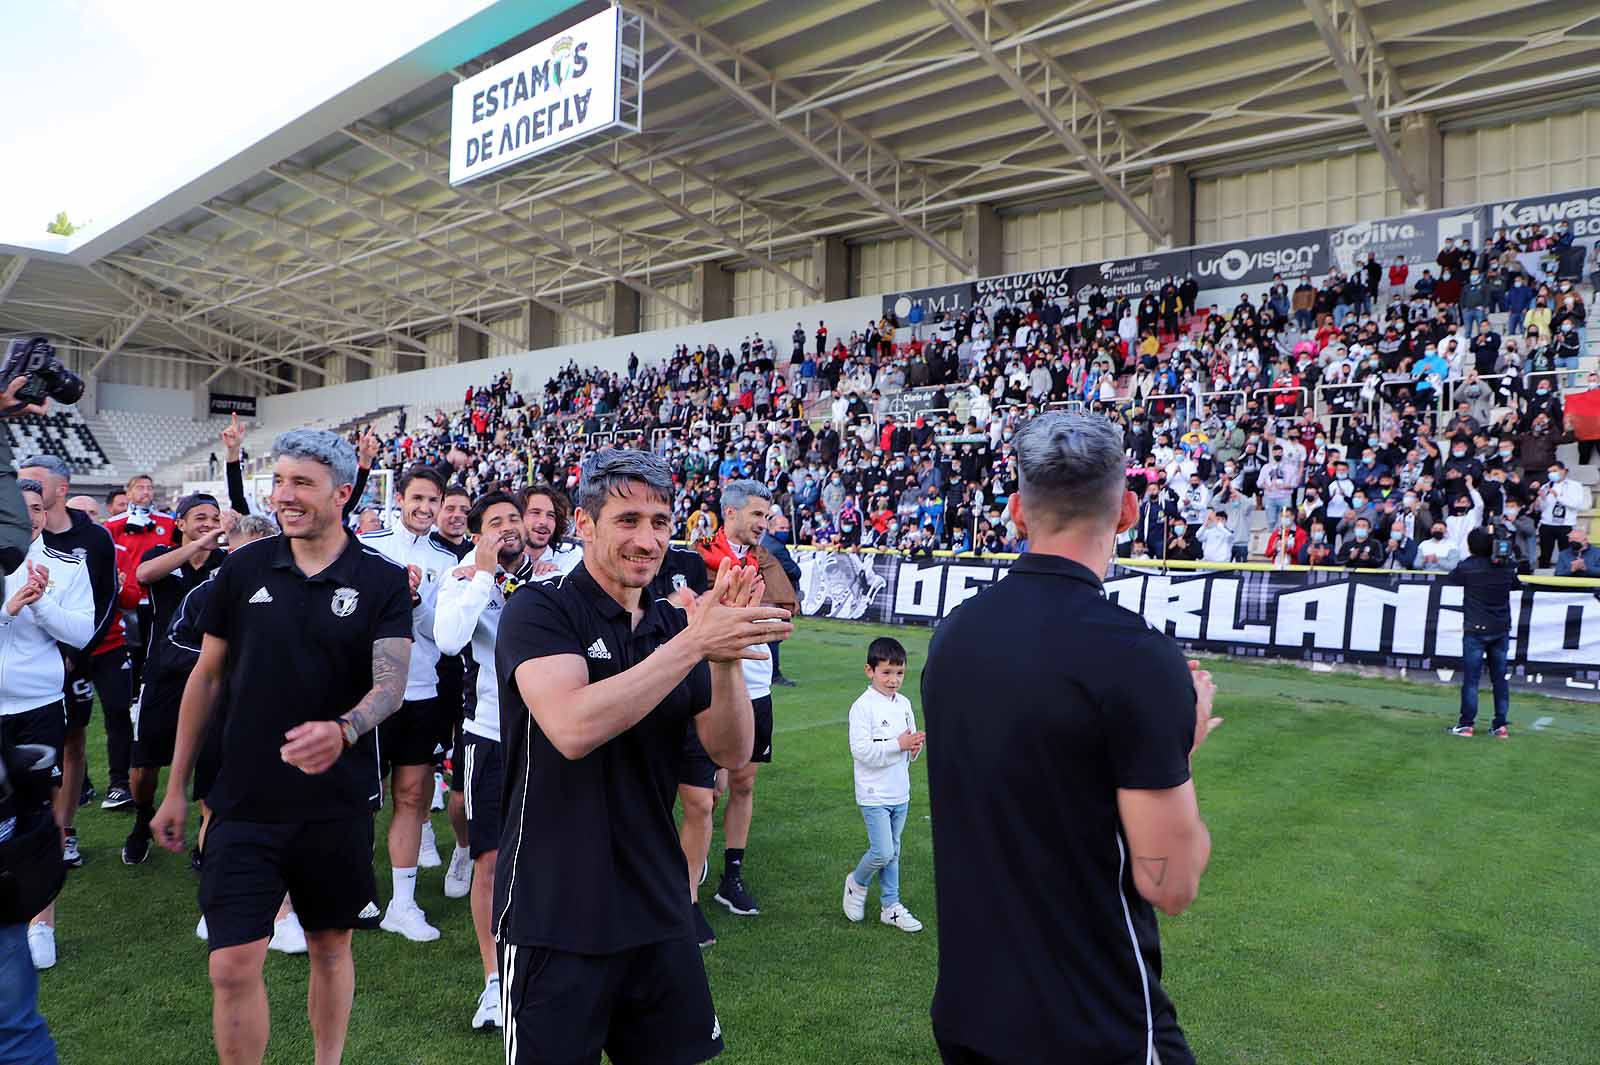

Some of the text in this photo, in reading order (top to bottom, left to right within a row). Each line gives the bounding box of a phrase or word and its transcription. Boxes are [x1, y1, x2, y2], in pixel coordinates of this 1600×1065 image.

[466, 130, 494, 168] DE
[976, 269, 1068, 293] EXCLUSIVAS
[928, 294, 964, 312] M.J.
[894, 563, 1010, 618] DE
